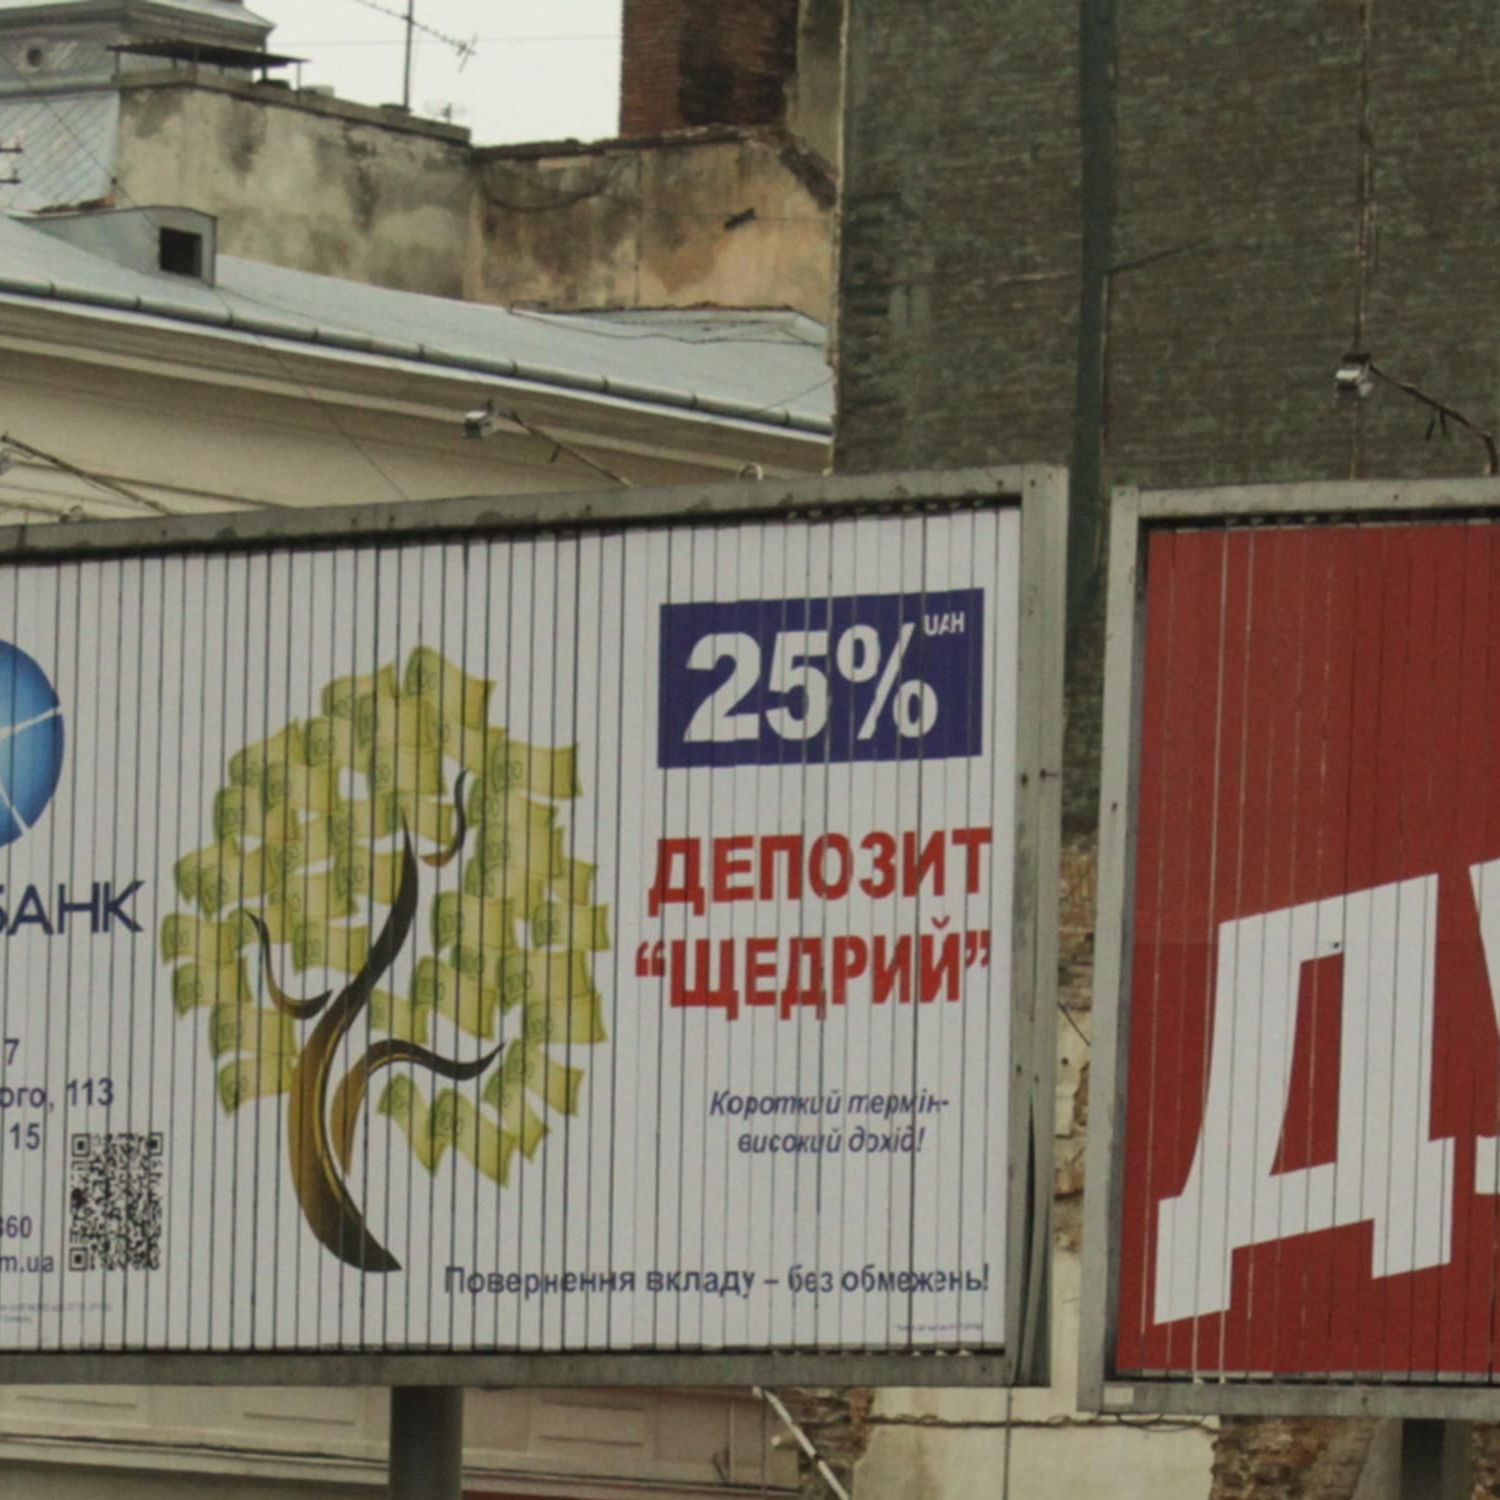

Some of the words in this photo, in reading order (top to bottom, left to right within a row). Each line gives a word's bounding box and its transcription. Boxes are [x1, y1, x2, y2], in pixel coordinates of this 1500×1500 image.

[683, 622, 938, 742] 25%
[924, 611, 965, 636] UAH
[647, 826, 993, 917] ДЕПОЗИТ
[66, 1078, 115, 1107] 113
[710, 1089, 841, 1120] Короткий
[10, 1123, 41, 1151] 15
[738, 1128, 841, 1153] високий
[848, 1126, 926, 1153] дохід!
[444, 1265, 636, 1300] Повернення
[646, 1269, 755, 1298] вкладу
[788, 1267, 834, 1293] без
[840, 1263, 990, 1294] обмежень!
